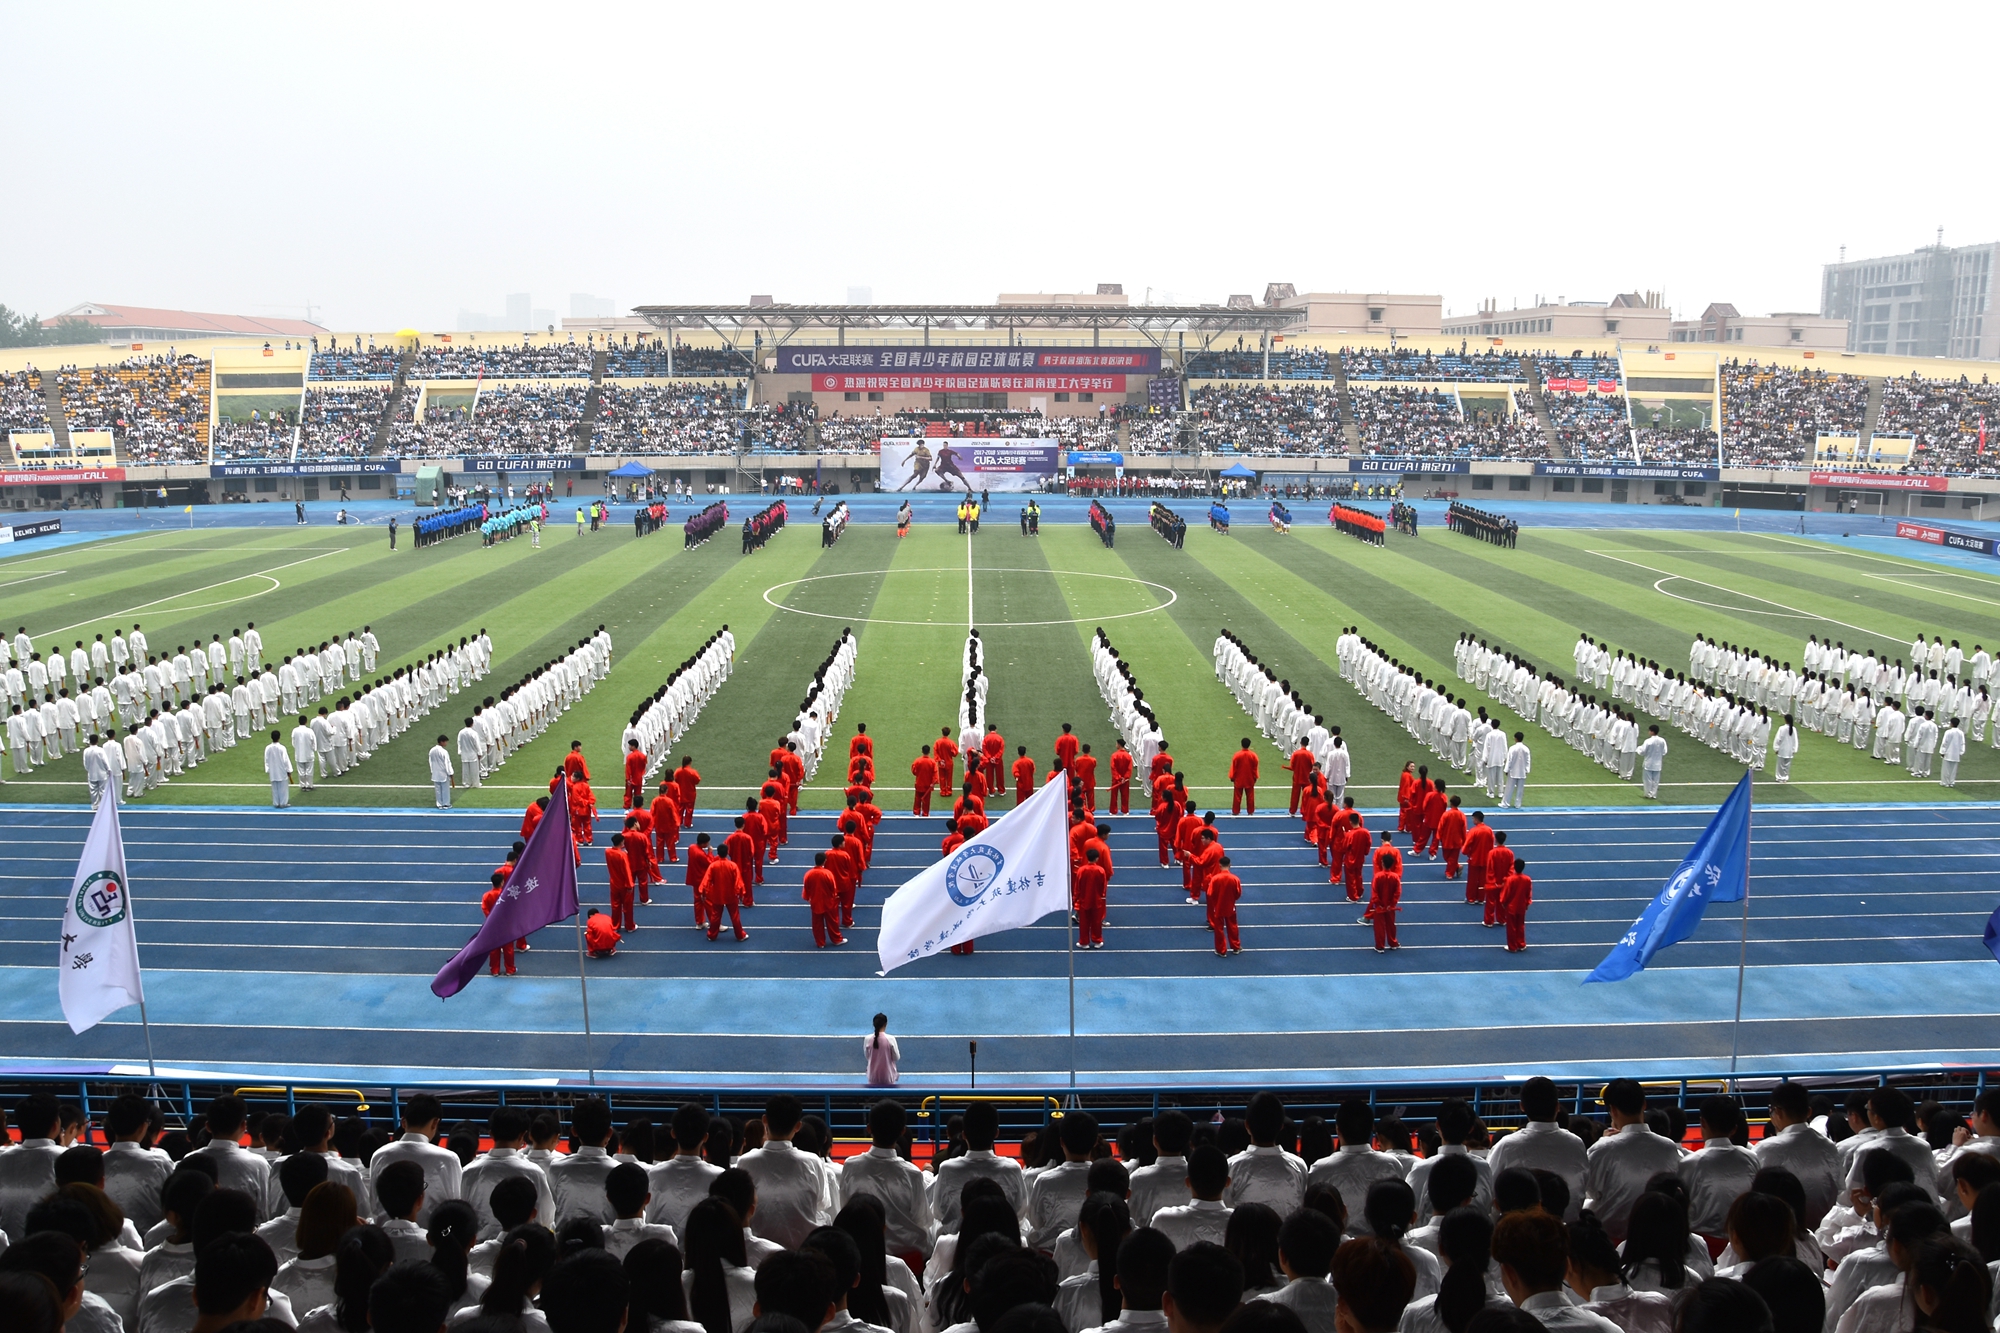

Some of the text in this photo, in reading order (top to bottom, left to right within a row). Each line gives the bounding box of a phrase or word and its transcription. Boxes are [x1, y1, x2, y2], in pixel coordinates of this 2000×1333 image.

[880, 352, 1035, 367] 全国青少年校园足球联赛
[844, 377, 1113, 390] 热烈祝贺全国青少年校园足球联赛在河南理工大学举行
[476, 461, 494, 470] GO
[497, 460, 534, 470] CUFA!
[974, 456, 996, 465] CUFA
[997, 456, 1026, 465] 大足联赛
[1362, 462, 1378, 470] GO
[1382, 462, 1418, 471] CUFA!
[1948, 536, 1964, 546] CUFA
